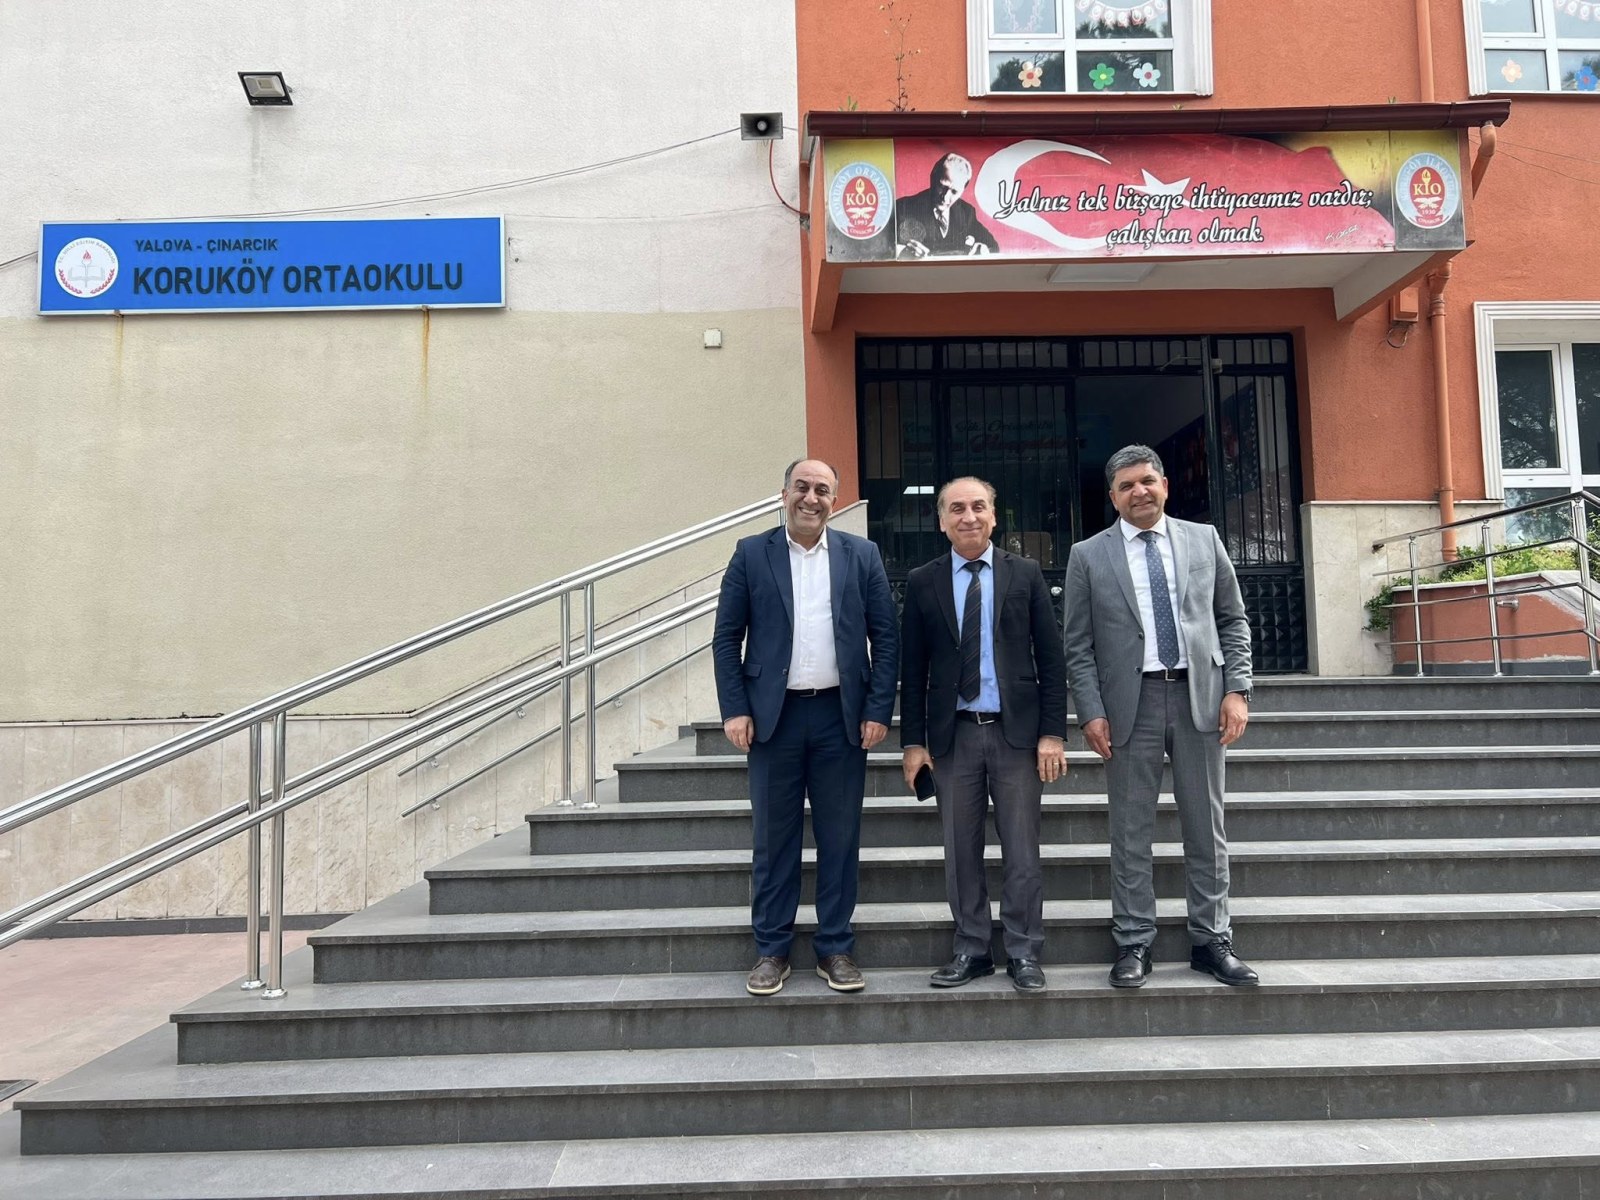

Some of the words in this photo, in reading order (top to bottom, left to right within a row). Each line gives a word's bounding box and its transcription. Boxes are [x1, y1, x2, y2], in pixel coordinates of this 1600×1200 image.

[993, 180, 1071, 219] Yalnız
[1077, 185, 1108, 211] tek
[1114, 183, 1183, 218] birşeye
[1190, 182, 1303, 217] ihtiyacımız
[1307, 179, 1374, 208] vardır;
[135, 239, 193, 252] YALOVA
[207, 238, 278, 254] ÇINARCIK
[1106, 218, 1191, 250] çalışkan
[1197, 216, 1264, 243] olmak.
[133, 257, 275, 295] KORUKÖY
[283, 262, 463, 293] ORTAOKULU
